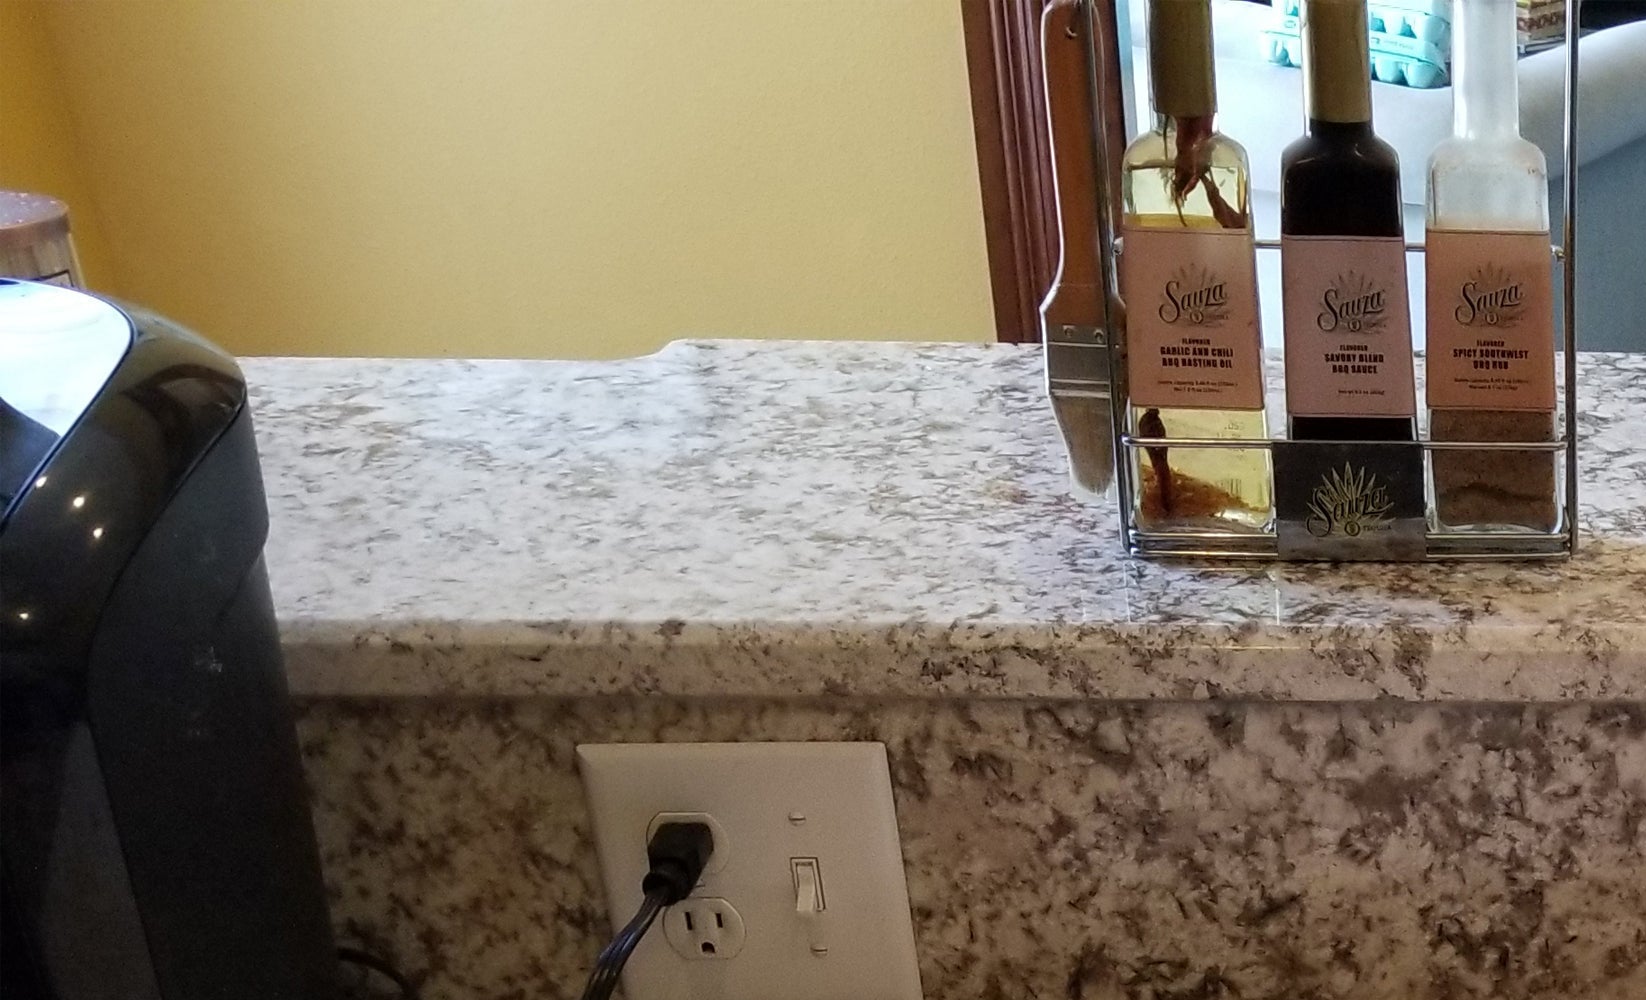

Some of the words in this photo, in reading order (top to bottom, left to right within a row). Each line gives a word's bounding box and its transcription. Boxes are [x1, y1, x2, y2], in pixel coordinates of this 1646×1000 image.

[1159, 280, 1227, 323] Sauza
[1455, 282, 1523, 326] Sauza
[1317, 288, 1385, 331] Sauza
[1160, 346, 1190, 356] GARLIC
[1192, 347, 1209, 357] AND
[1211, 348, 1234, 358] CHILI
[1453, 348, 1477, 358] SPICY
[1480, 349, 1529, 359] SOUTHWEST
[1162, 358, 1179, 368] BBQ
[1181, 358, 1218, 368] BASTING
[1219, 359, 1232, 369] OIL
[1324, 353, 1356, 363] SAVORY
[1358, 354, 1384, 363] BLEND
[1332, 364, 1349, 375] BBQ
[1351, 365, 1378, 375] SAUCE
[1473, 360, 1490, 370] BBQ
[1492, 361, 1509, 370] RUB
[1306, 485, 1389, 537] Sauza
